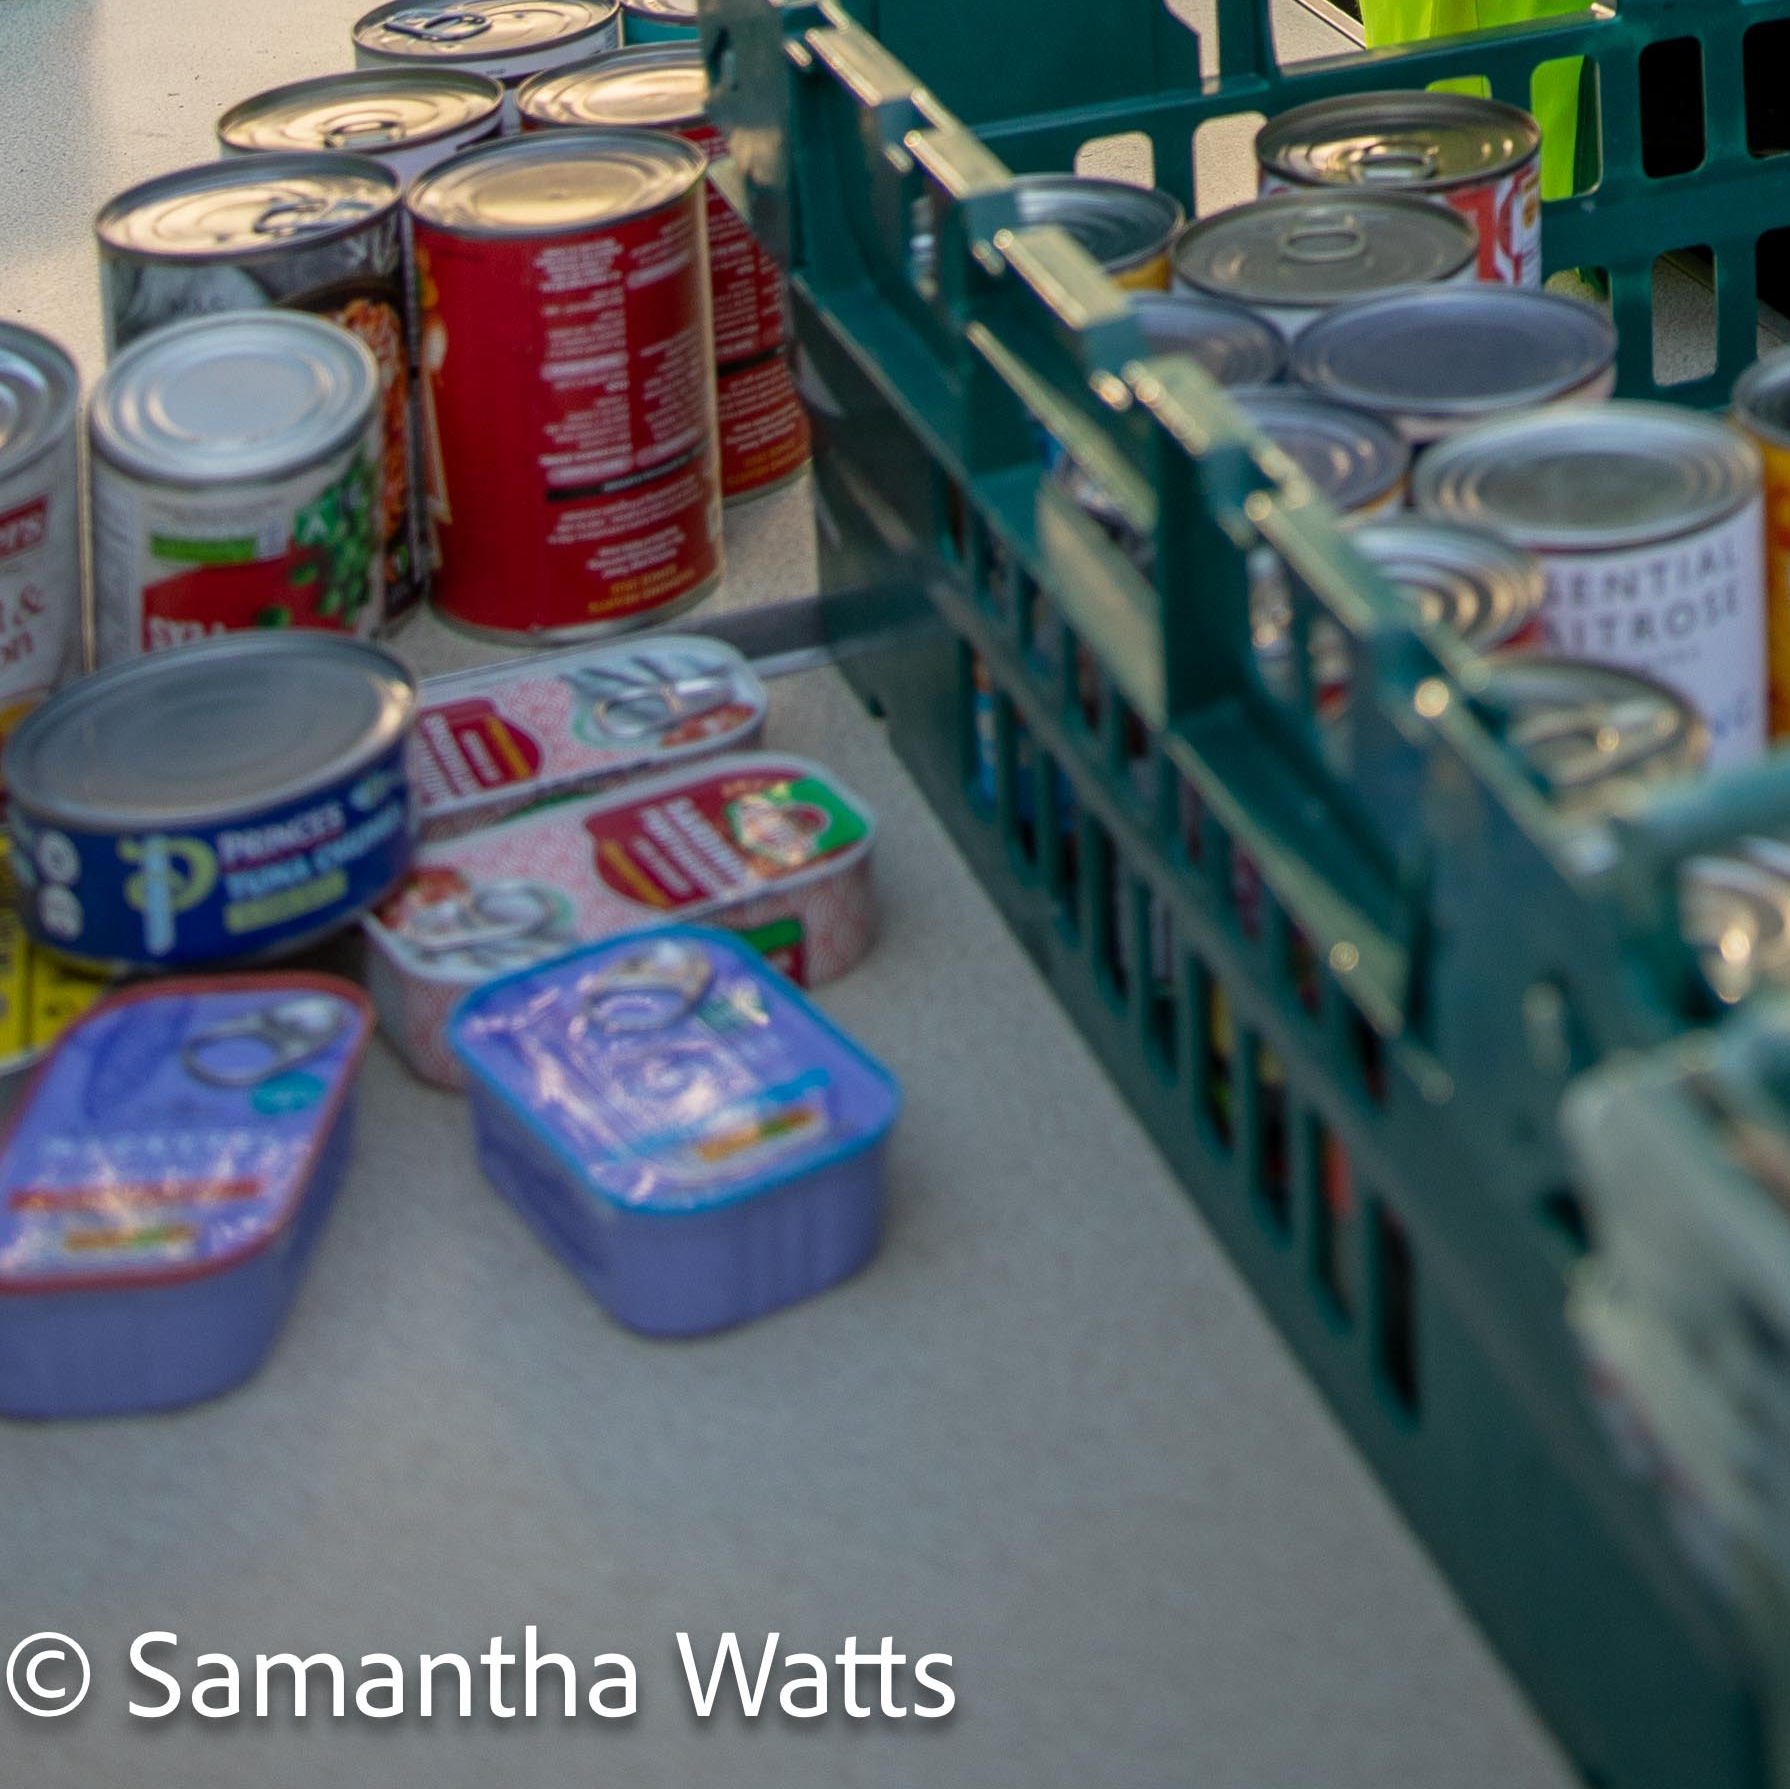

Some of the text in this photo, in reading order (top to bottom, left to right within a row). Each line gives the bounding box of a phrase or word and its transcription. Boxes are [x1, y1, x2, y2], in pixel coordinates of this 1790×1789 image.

[1547, 536, 1738, 607] SENTIAL
[1546, 582, 1739, 647] AITROSE
[216, 800, 346, 864] PRINCES
